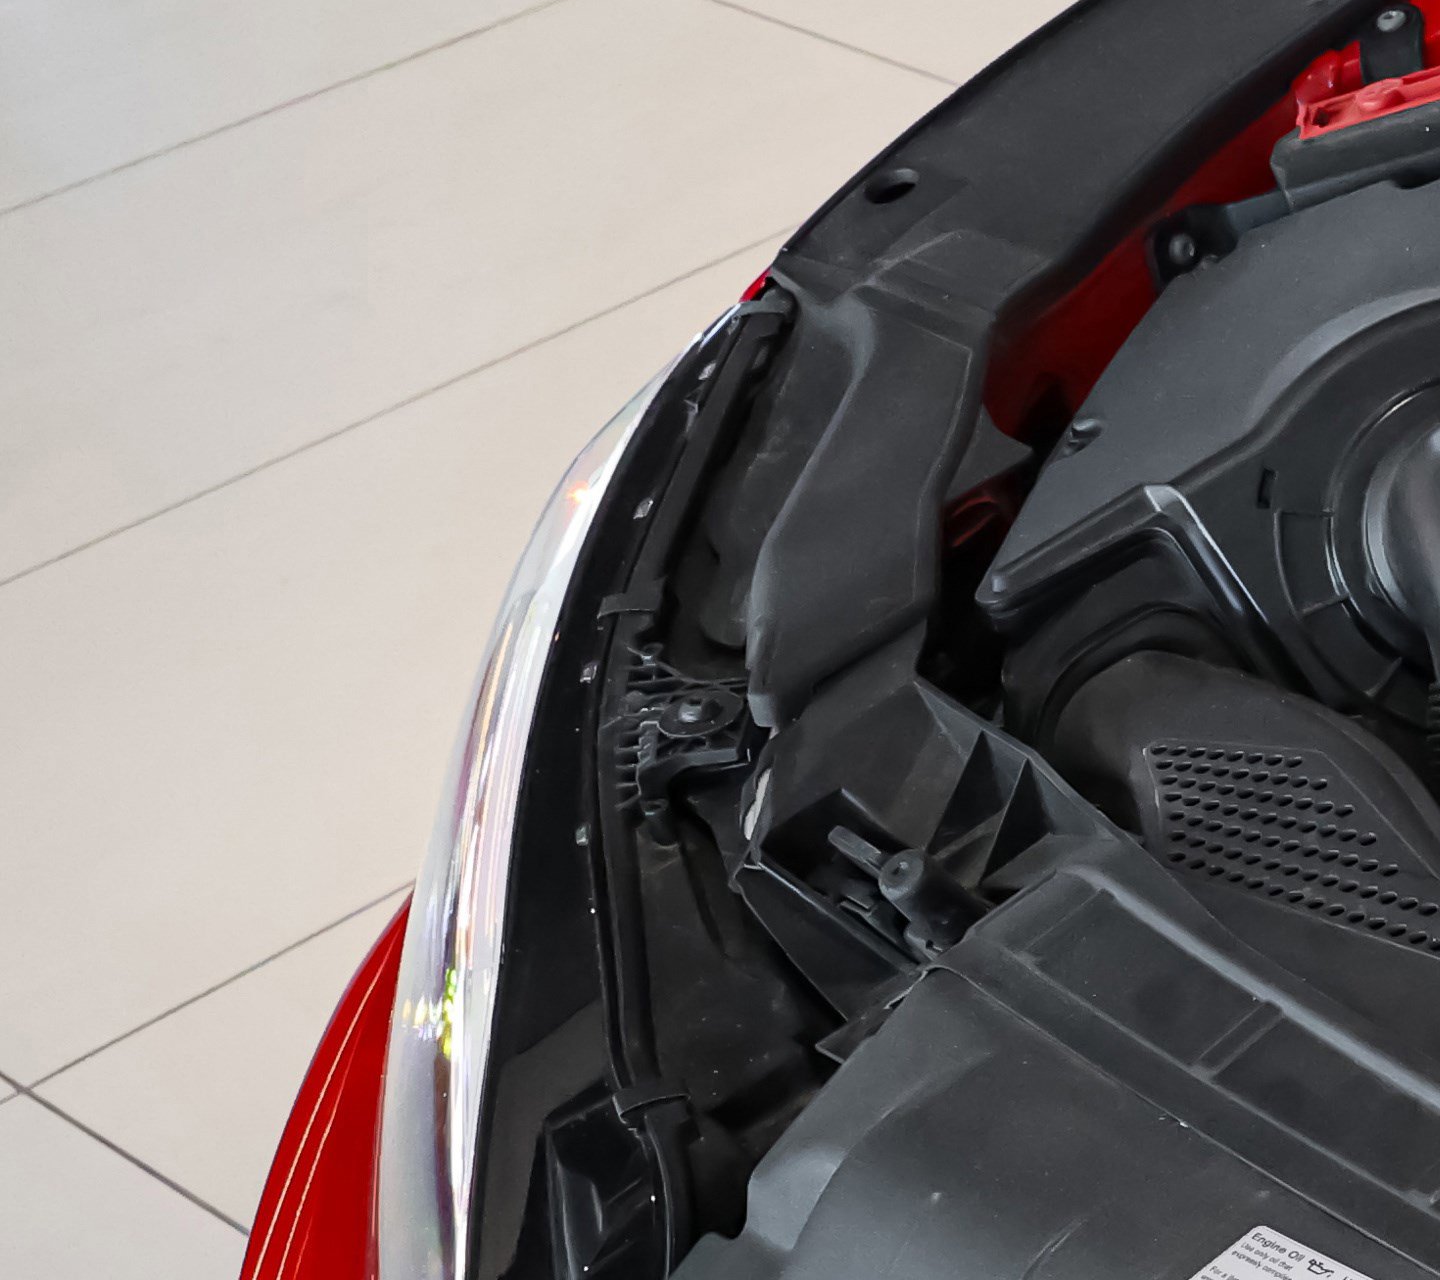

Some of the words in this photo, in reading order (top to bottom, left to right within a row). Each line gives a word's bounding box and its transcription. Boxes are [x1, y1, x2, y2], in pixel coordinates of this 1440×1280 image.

[1251, 1232, 1287, 1254] Engine
[1287, 1250, 1306, 1262] Oil
[1209, 1265, 1223, 1275] For
